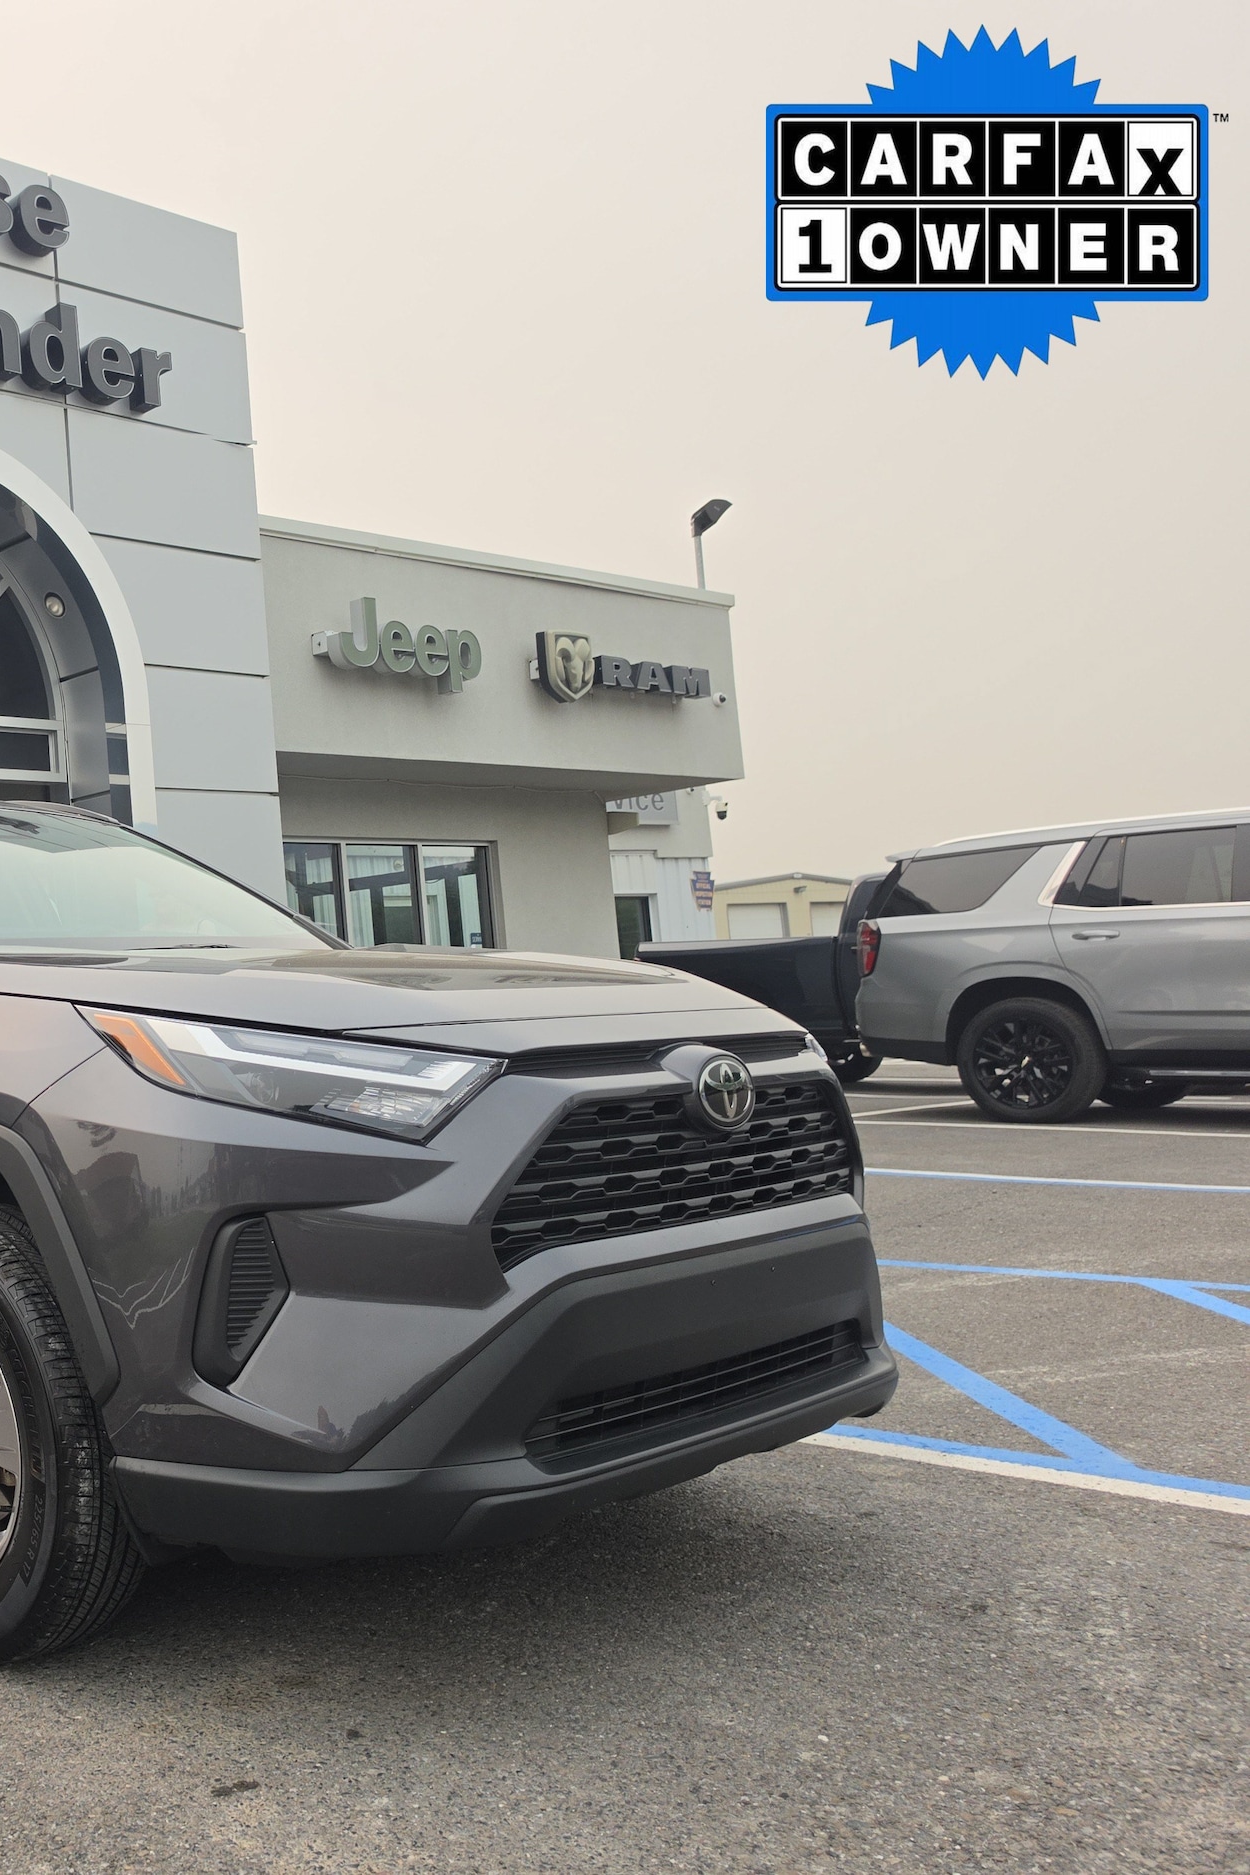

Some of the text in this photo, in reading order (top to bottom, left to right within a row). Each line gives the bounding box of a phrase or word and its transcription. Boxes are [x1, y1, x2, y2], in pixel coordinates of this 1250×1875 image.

[328, 597, 482, 695] Jeep
[592, 654, 711, 700] RAM
[30, 1494, 44, 1549] 225/65
[22, 1560, 32, 1578] 17
